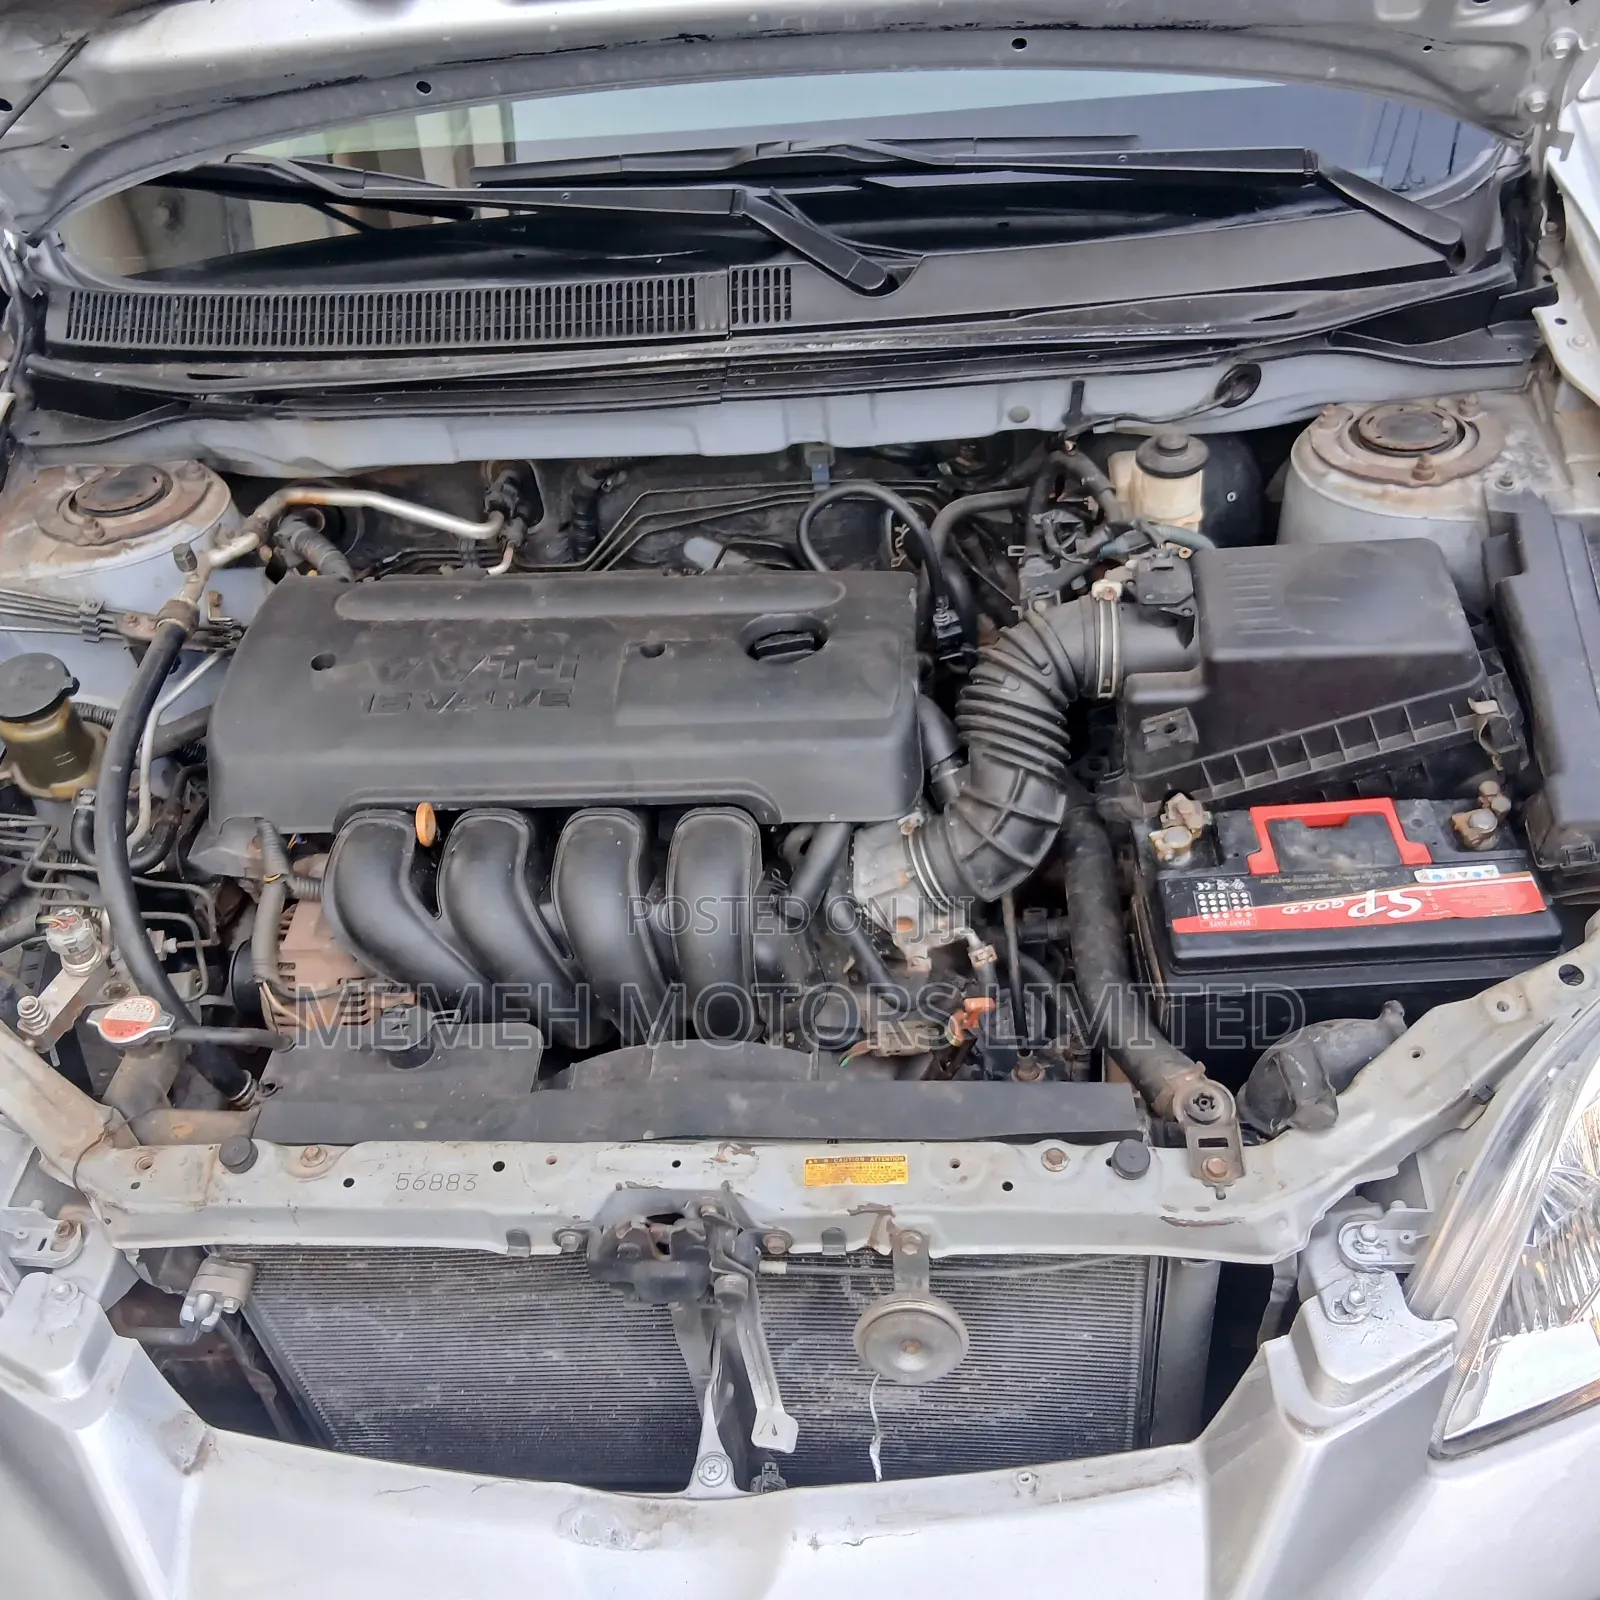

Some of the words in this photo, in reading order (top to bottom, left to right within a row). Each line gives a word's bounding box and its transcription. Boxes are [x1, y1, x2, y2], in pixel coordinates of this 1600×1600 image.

[1281, 899, 1345, 915] GOLD
[1347, 889, 1423, 919] SP
[1209, 920, 1228, 928] DATE
[395, 1172, 479, 1192] 56883
